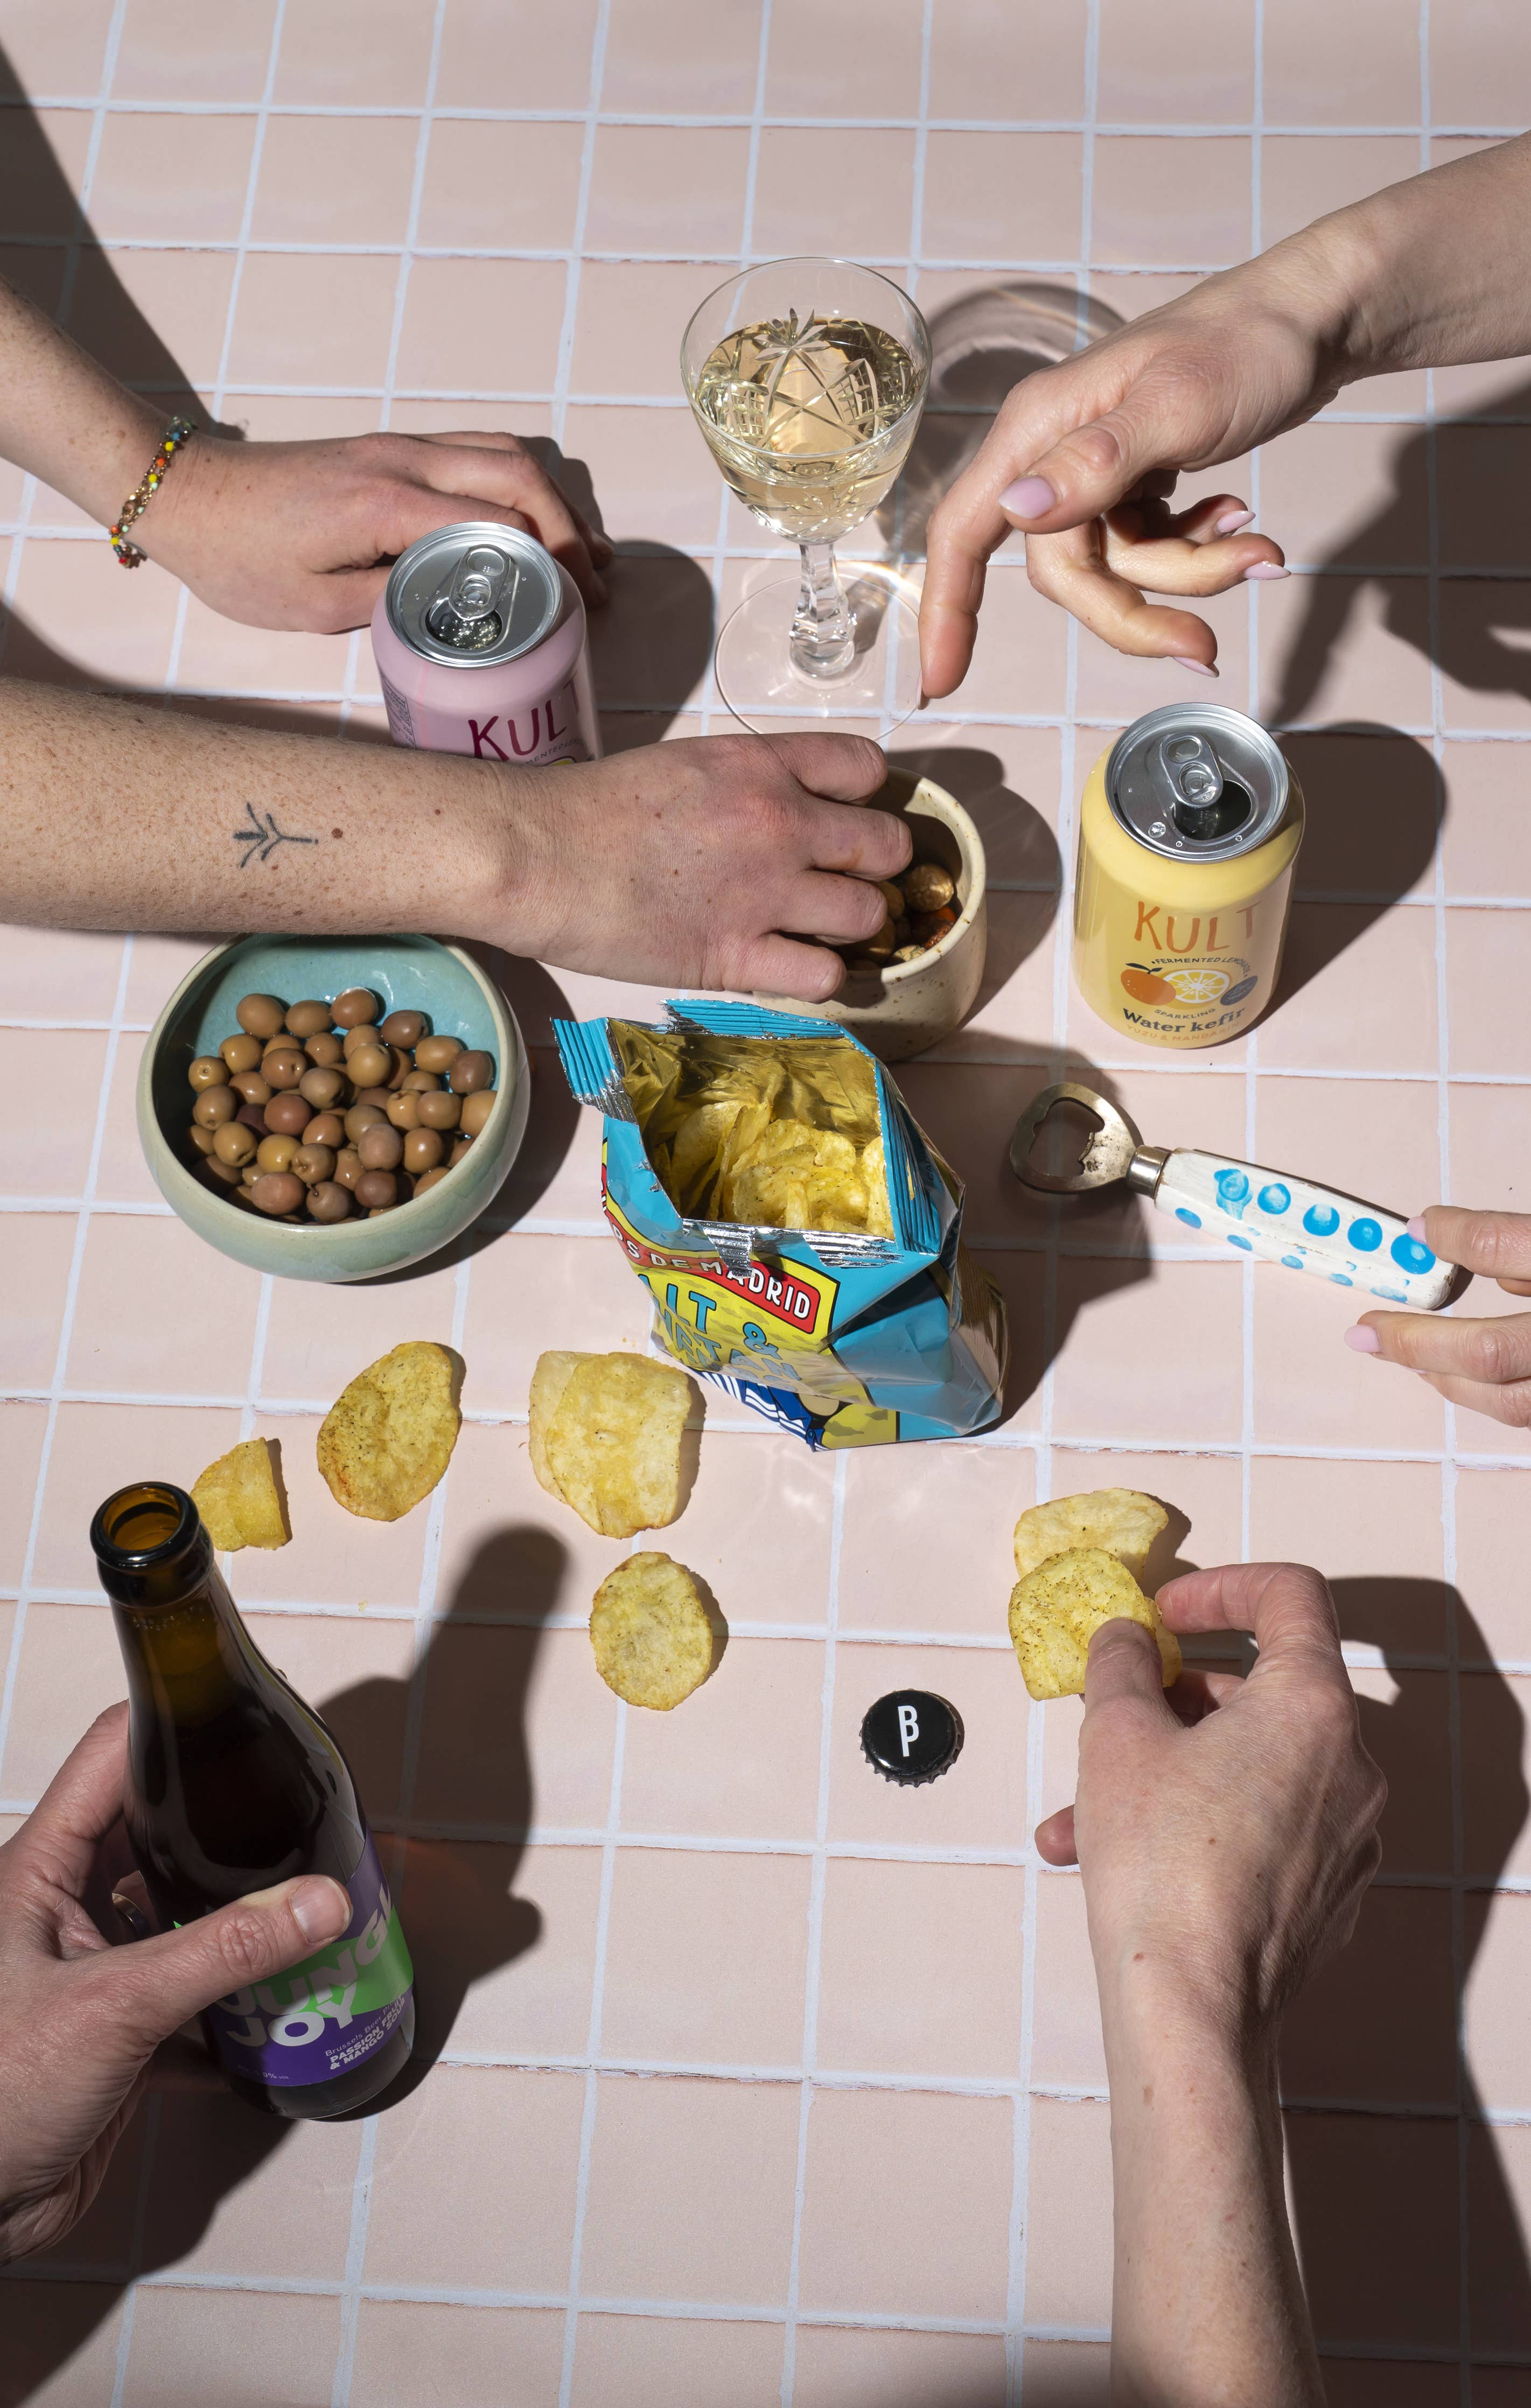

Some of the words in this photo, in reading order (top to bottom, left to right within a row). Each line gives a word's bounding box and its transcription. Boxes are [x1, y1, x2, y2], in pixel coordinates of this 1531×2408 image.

[1134, 900, 1262, 953] KULT
[1123, 1007, 1185, 1032] Water
[1190, 1007, 1245, 1032] kefir
[1127, 1024, 1157, 1039] YUZU
[1172, 1021, 1240, 1041] MANDARIN
[1154, 1007, 1216, 1019] SPARKLING
[651, 1252, 690, 1270] DE
[743, 1321, 783, 1361] &
[225, 1982, 356, 2047] JOY
[330, 2062, 341, 2070] &
[343, 2030, 385, 2064] MANGO
[386, 1997, 405, 2031] SOUR
[325, 2033, 363, 2057] Brussels
[364, 2017, 381, 2034] Beer
[330, 2026, 380, 2063] PASSION
